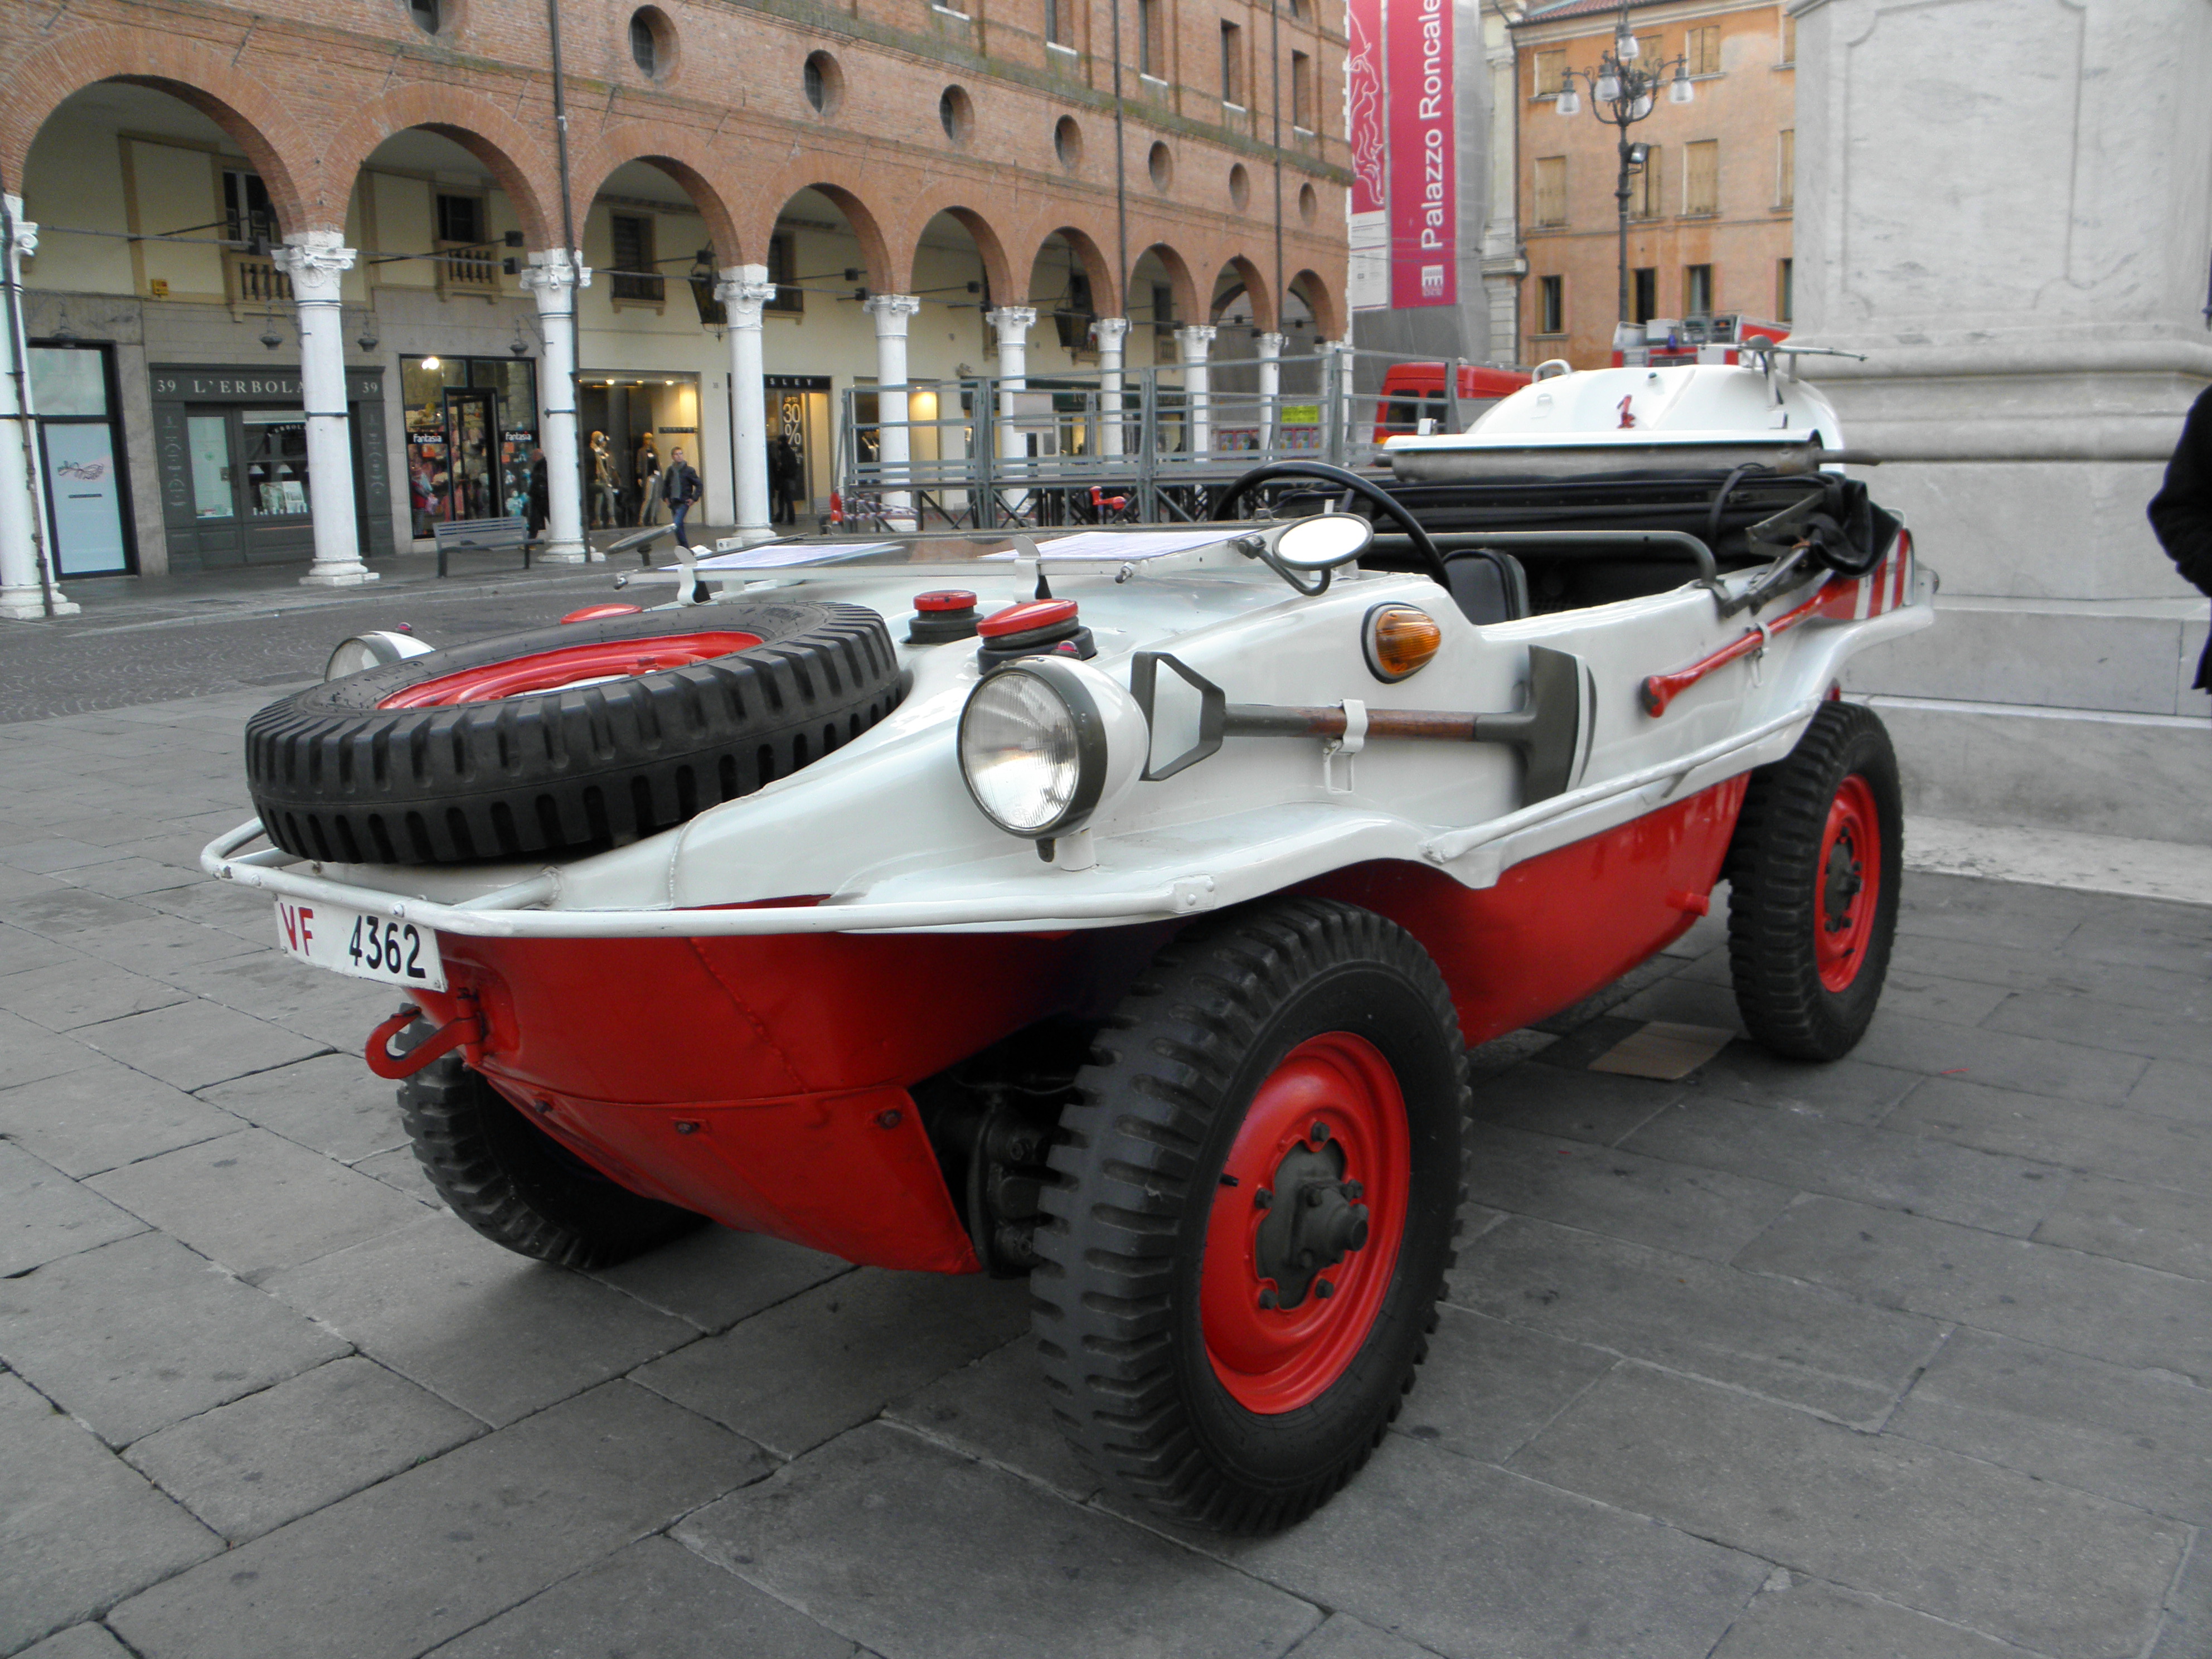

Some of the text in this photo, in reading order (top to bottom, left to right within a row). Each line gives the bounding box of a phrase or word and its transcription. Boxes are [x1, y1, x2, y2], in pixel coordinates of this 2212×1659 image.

[1418, 0, 1443, 249] Palazzo Roncale
[158, 380, 176, 392] 39
[363, 382, 377, 392] 39
[783, 403, 801, 423] 30
[413, 433, 442, 443] fantasia
[506, 431, 532, 441] fantasia
[280, 902, 426, 978] VF 4362
